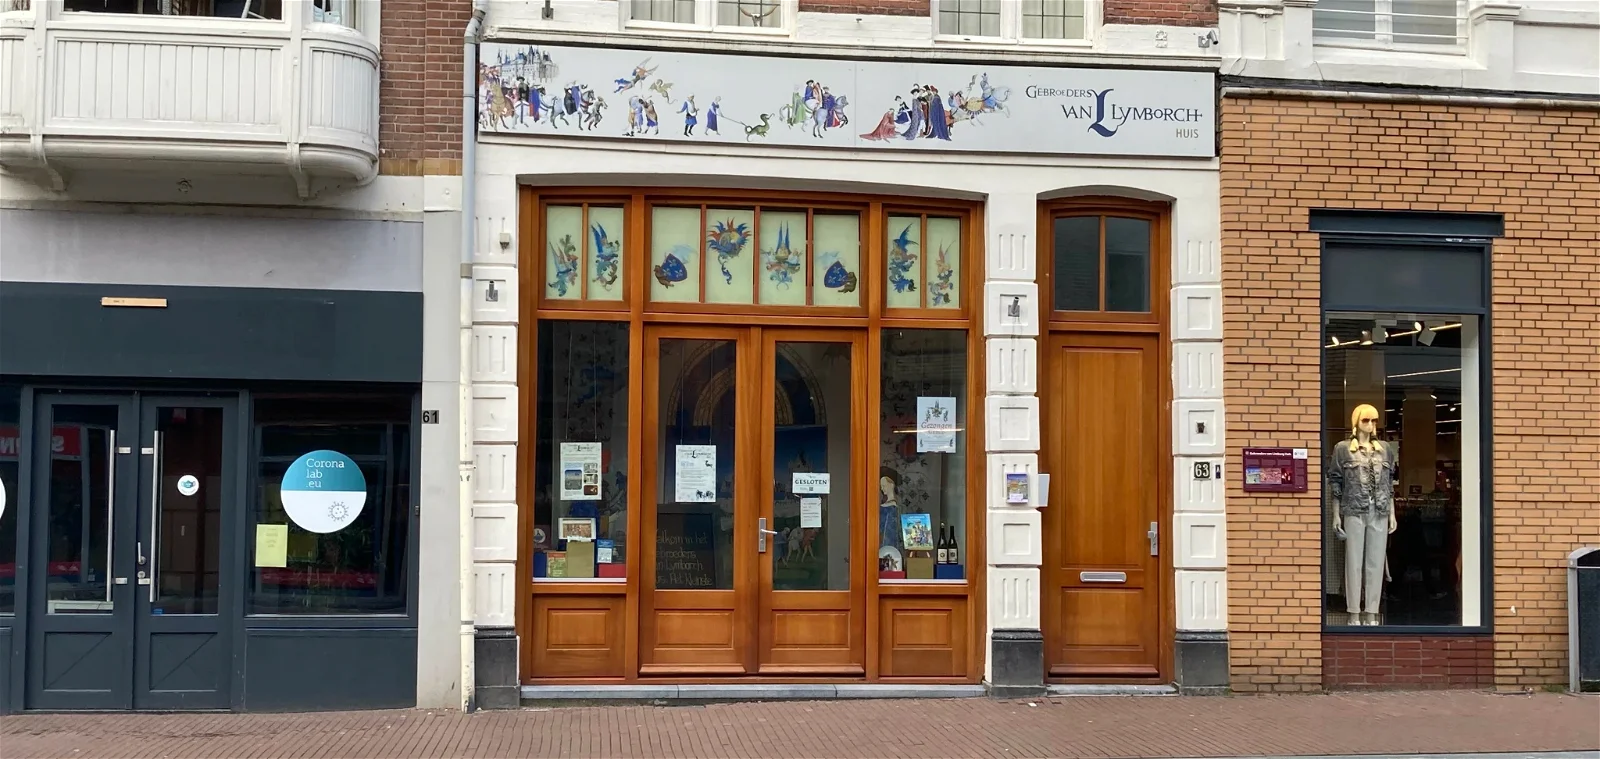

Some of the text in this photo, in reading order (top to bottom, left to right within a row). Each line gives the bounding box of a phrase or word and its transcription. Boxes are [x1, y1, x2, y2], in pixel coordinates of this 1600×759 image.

[1025, 85, 1092, 99] GEBROEDERS
[1061, 104, 1092, 119] VAN
[1175, 128, 1199, 139] HUIS
[422, 410, 437, 424] 61
[306, 458, 344, 468] Corona
[1195, 463, 1209, 477] 63
[306, 469, 323, 479] lab
[655, 528, 684, 545] elkom
[656, 546, 697, 559] ebroeders
